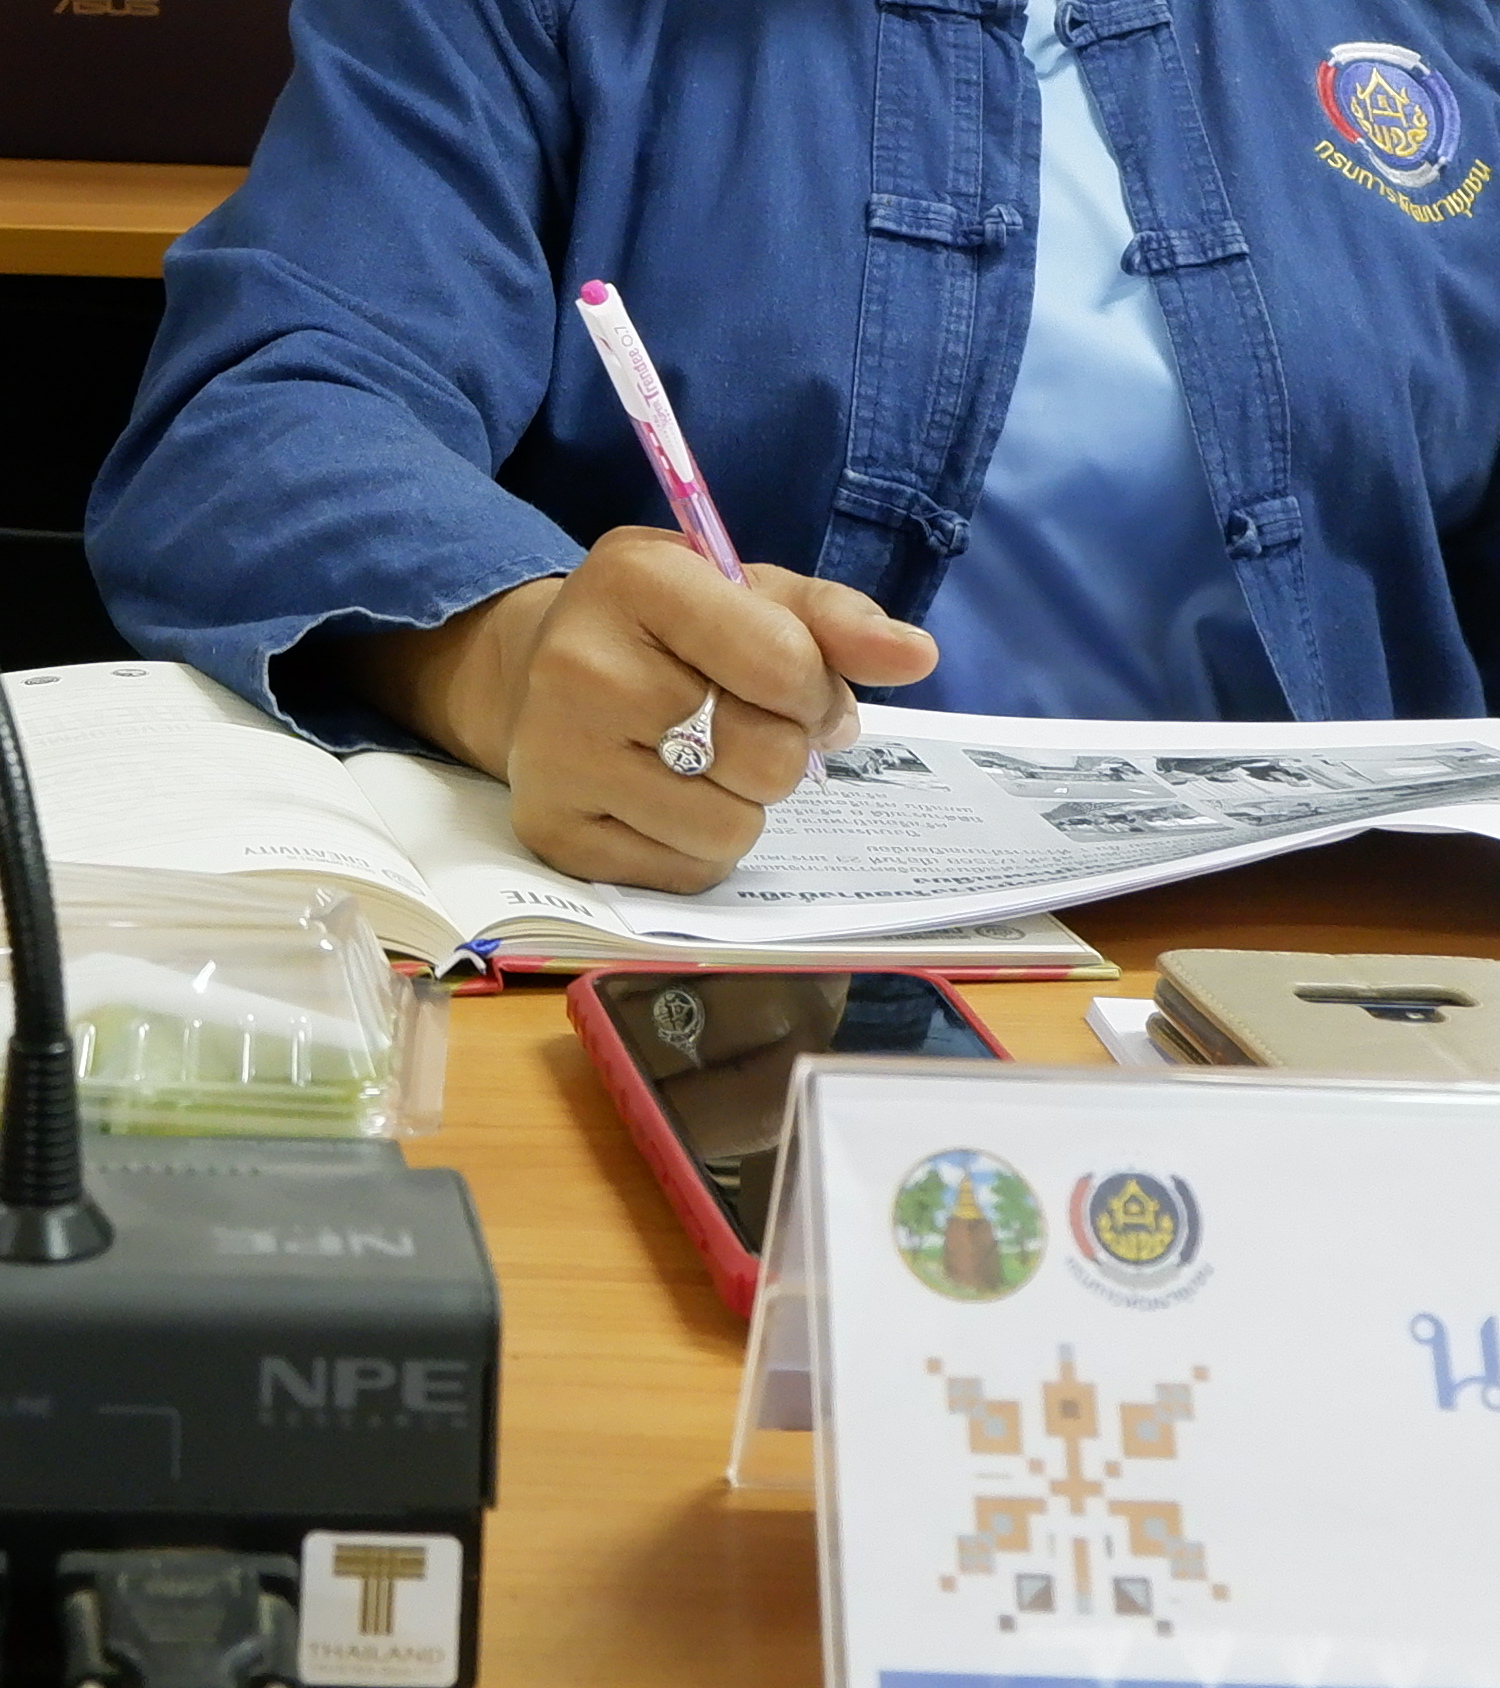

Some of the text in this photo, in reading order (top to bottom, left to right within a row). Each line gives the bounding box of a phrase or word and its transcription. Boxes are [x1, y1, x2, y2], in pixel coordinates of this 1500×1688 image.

[1314, 138, 1493, 223] กรมการพัฒนาชุมชน
[499, 890, 594, 918] NOTE
[259, 1356, 470, 1412] NPE
[308, 1642, 446, 1663] THAILAND
